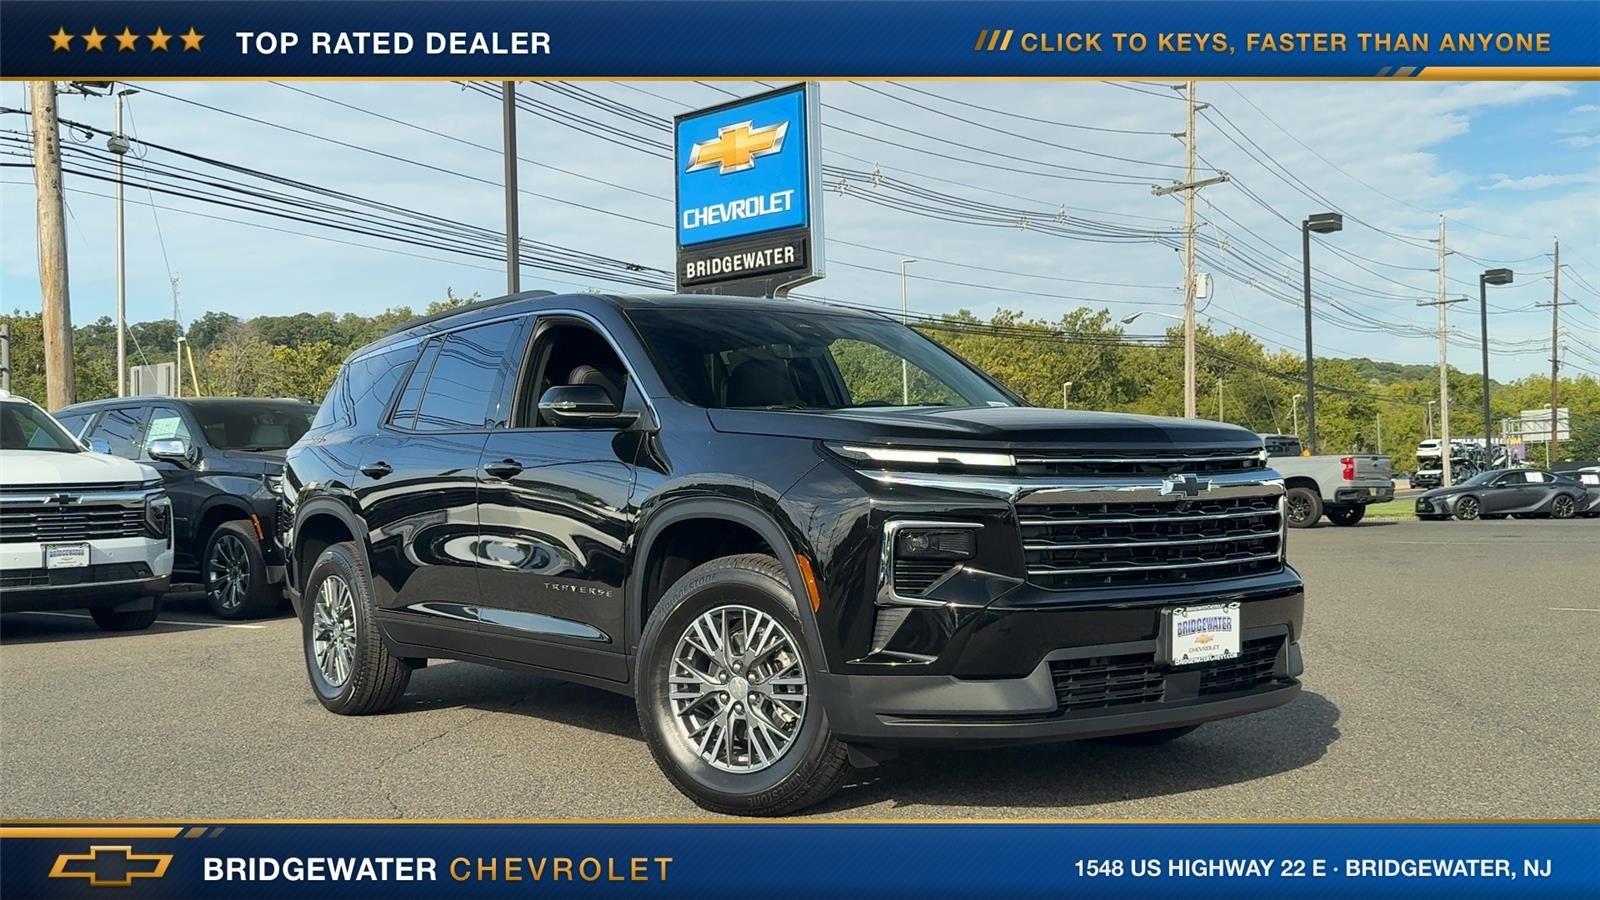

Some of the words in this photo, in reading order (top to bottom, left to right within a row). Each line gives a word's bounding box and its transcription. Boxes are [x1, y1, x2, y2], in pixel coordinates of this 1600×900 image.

[683, 189, 795, 230] CHEVROLET
[686, 246, 795, 279] BRIDGEWATER
[544, 582, 614, 597] TRAVERSE
[1177, 616, 1232, 637] BRIDGEWATER
[1188, 644, 1220, 653] CHEVROLET
